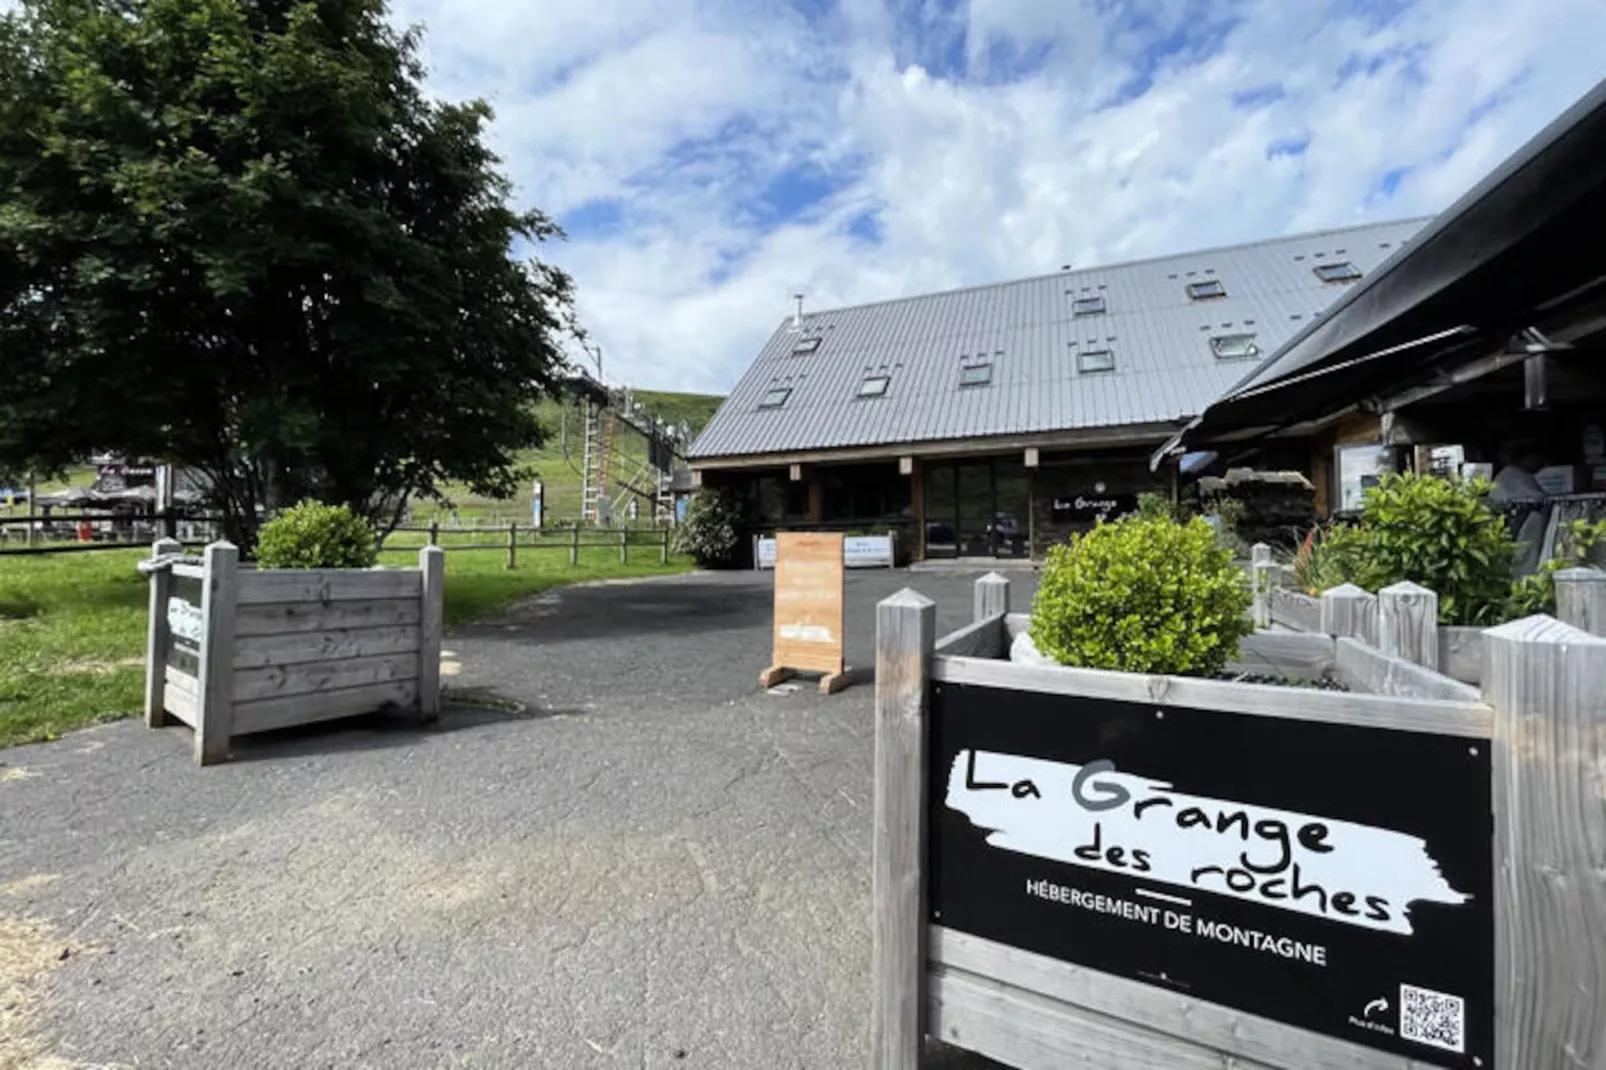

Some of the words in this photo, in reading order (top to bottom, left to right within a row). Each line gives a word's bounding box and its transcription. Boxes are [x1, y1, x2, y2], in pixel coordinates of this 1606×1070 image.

[966, 750, 1041, 799] La
[1071, 759, 1335, 874] Grange
[1074, 821, 1151, 872] des
[1191, 861, 1391, 921] roches
[1026, 879, 1160, 925] HÉBERGEMENT
[1163, 909, 1192, 934] DE
[1196, 918, 1327, 967] MONTAGNE
